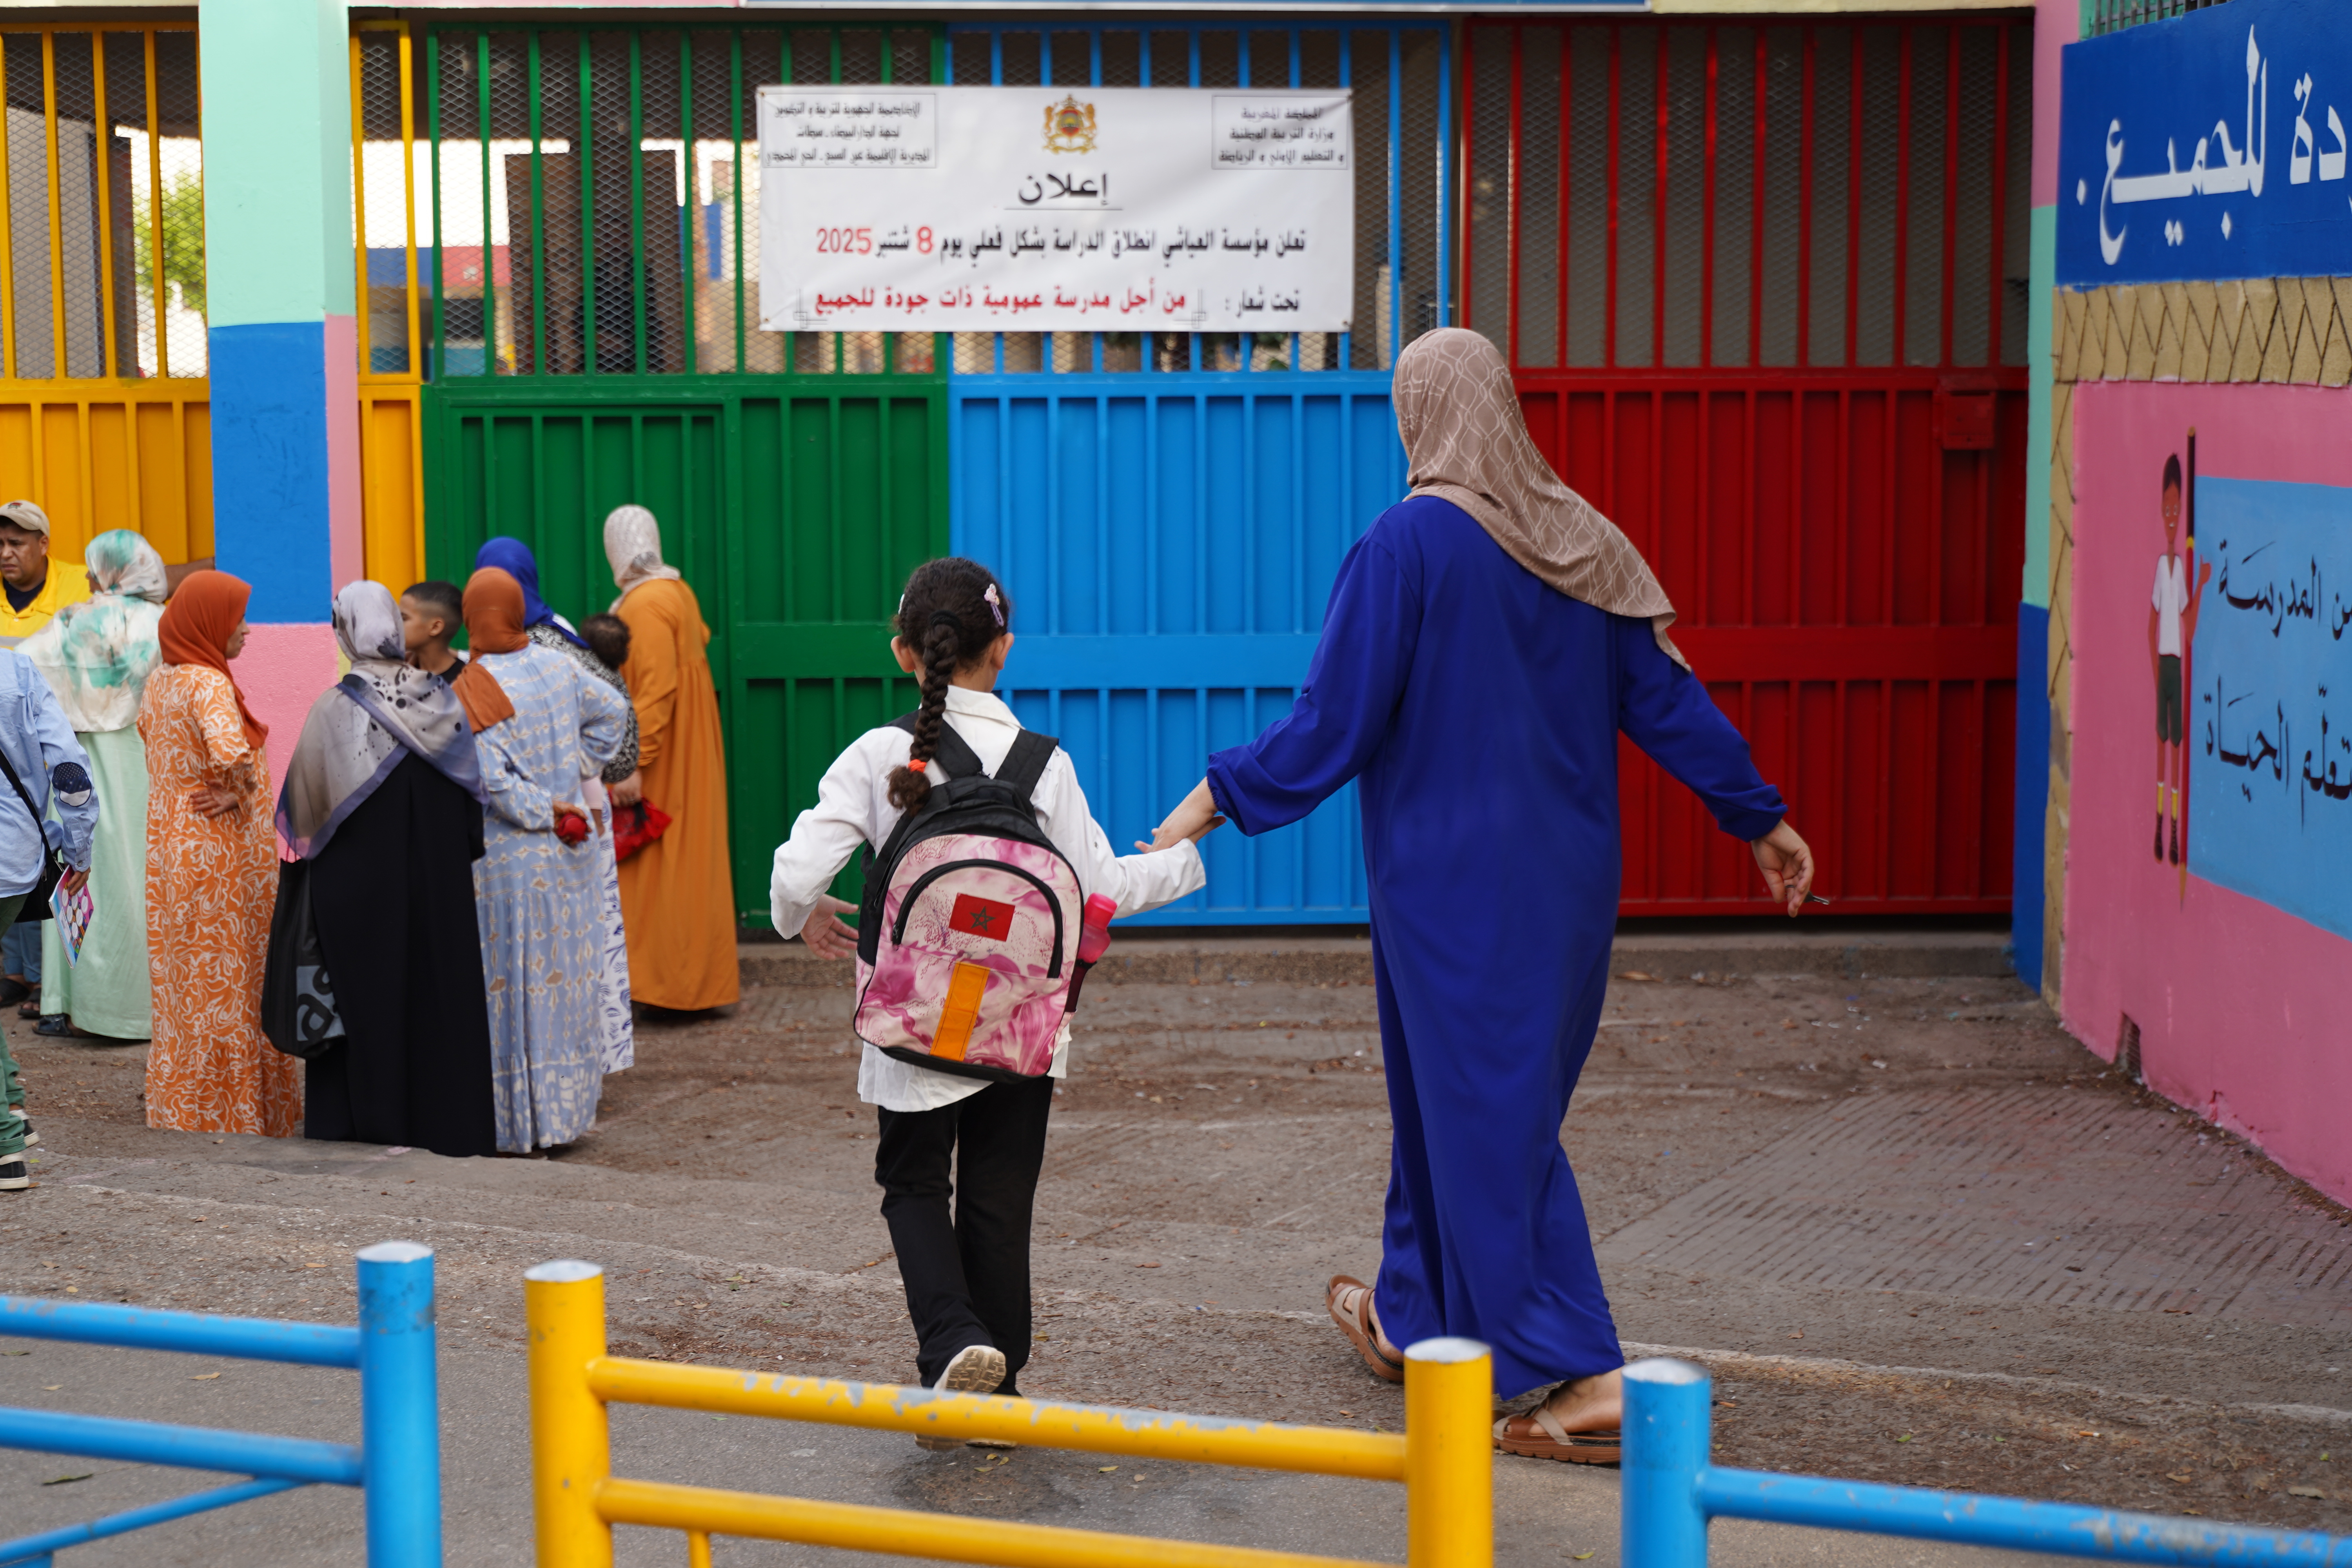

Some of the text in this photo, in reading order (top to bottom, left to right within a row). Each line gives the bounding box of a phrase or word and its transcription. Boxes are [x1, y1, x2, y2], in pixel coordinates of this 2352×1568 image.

[1018, 173, 1109, 206] إعلان
[817, 228, 872, 255] 2025
[916, 226, 933, 254] 8
[940, 233, 962, 265] يوم
[969, 225, 1002, 268] فعلي
[1009, 225, 1045, 259] بشكل
[1053, 229, 1104, 257] الدراسة
[1221, 228, 1269, 257] مؤسسة
[1277, 229, 1306, 258] تعلن
[815, 286, 875, 315] للجميع
[884, 285, 929, 314] جودة
[938, 285, 973, 307] ذات
[983, 285, 1043, 314] عمومية
[1053, 285, 1110, 314] مدرسة
[1120, 276, 1154, 314] أجل
[1163, 292, 1185, 313] من
[1236, 285, 1264, 318] شعار
[1271, 289, 1300, 312] تحت
